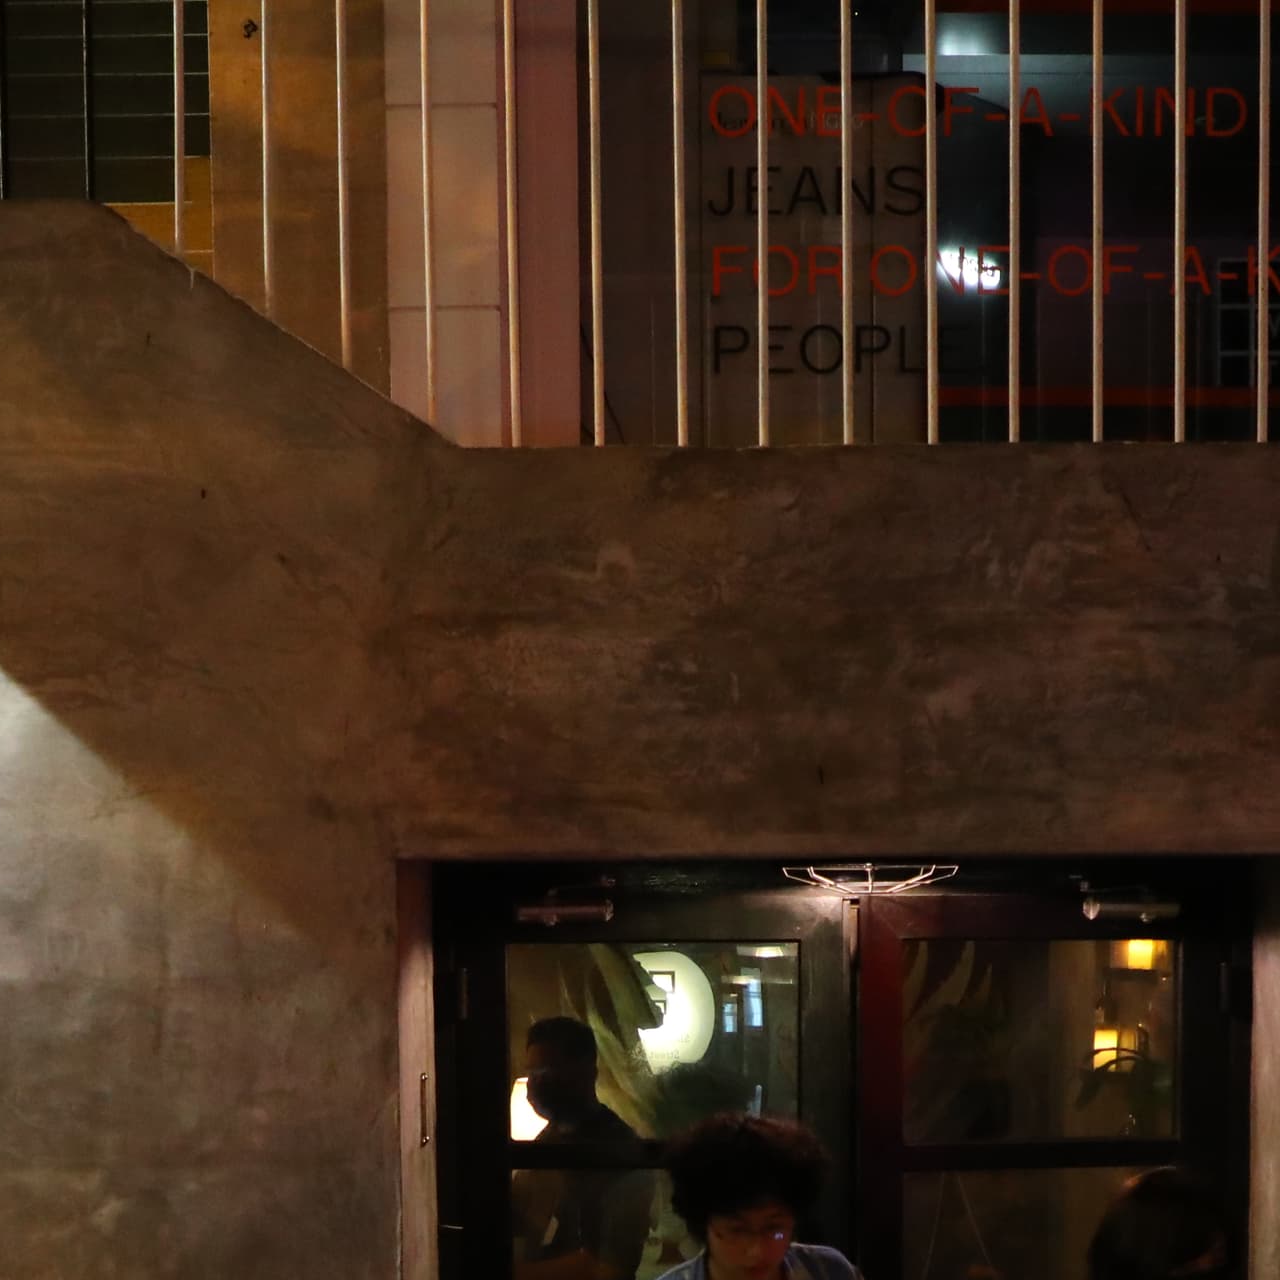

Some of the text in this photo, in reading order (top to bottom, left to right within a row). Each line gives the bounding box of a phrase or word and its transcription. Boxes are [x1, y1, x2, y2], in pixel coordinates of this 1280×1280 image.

[708, 85, 1249, 137] ONE-OF-A-KIND
[708, 166, 928, 216] JEANS
[712, 245, 847, 297] FOR
